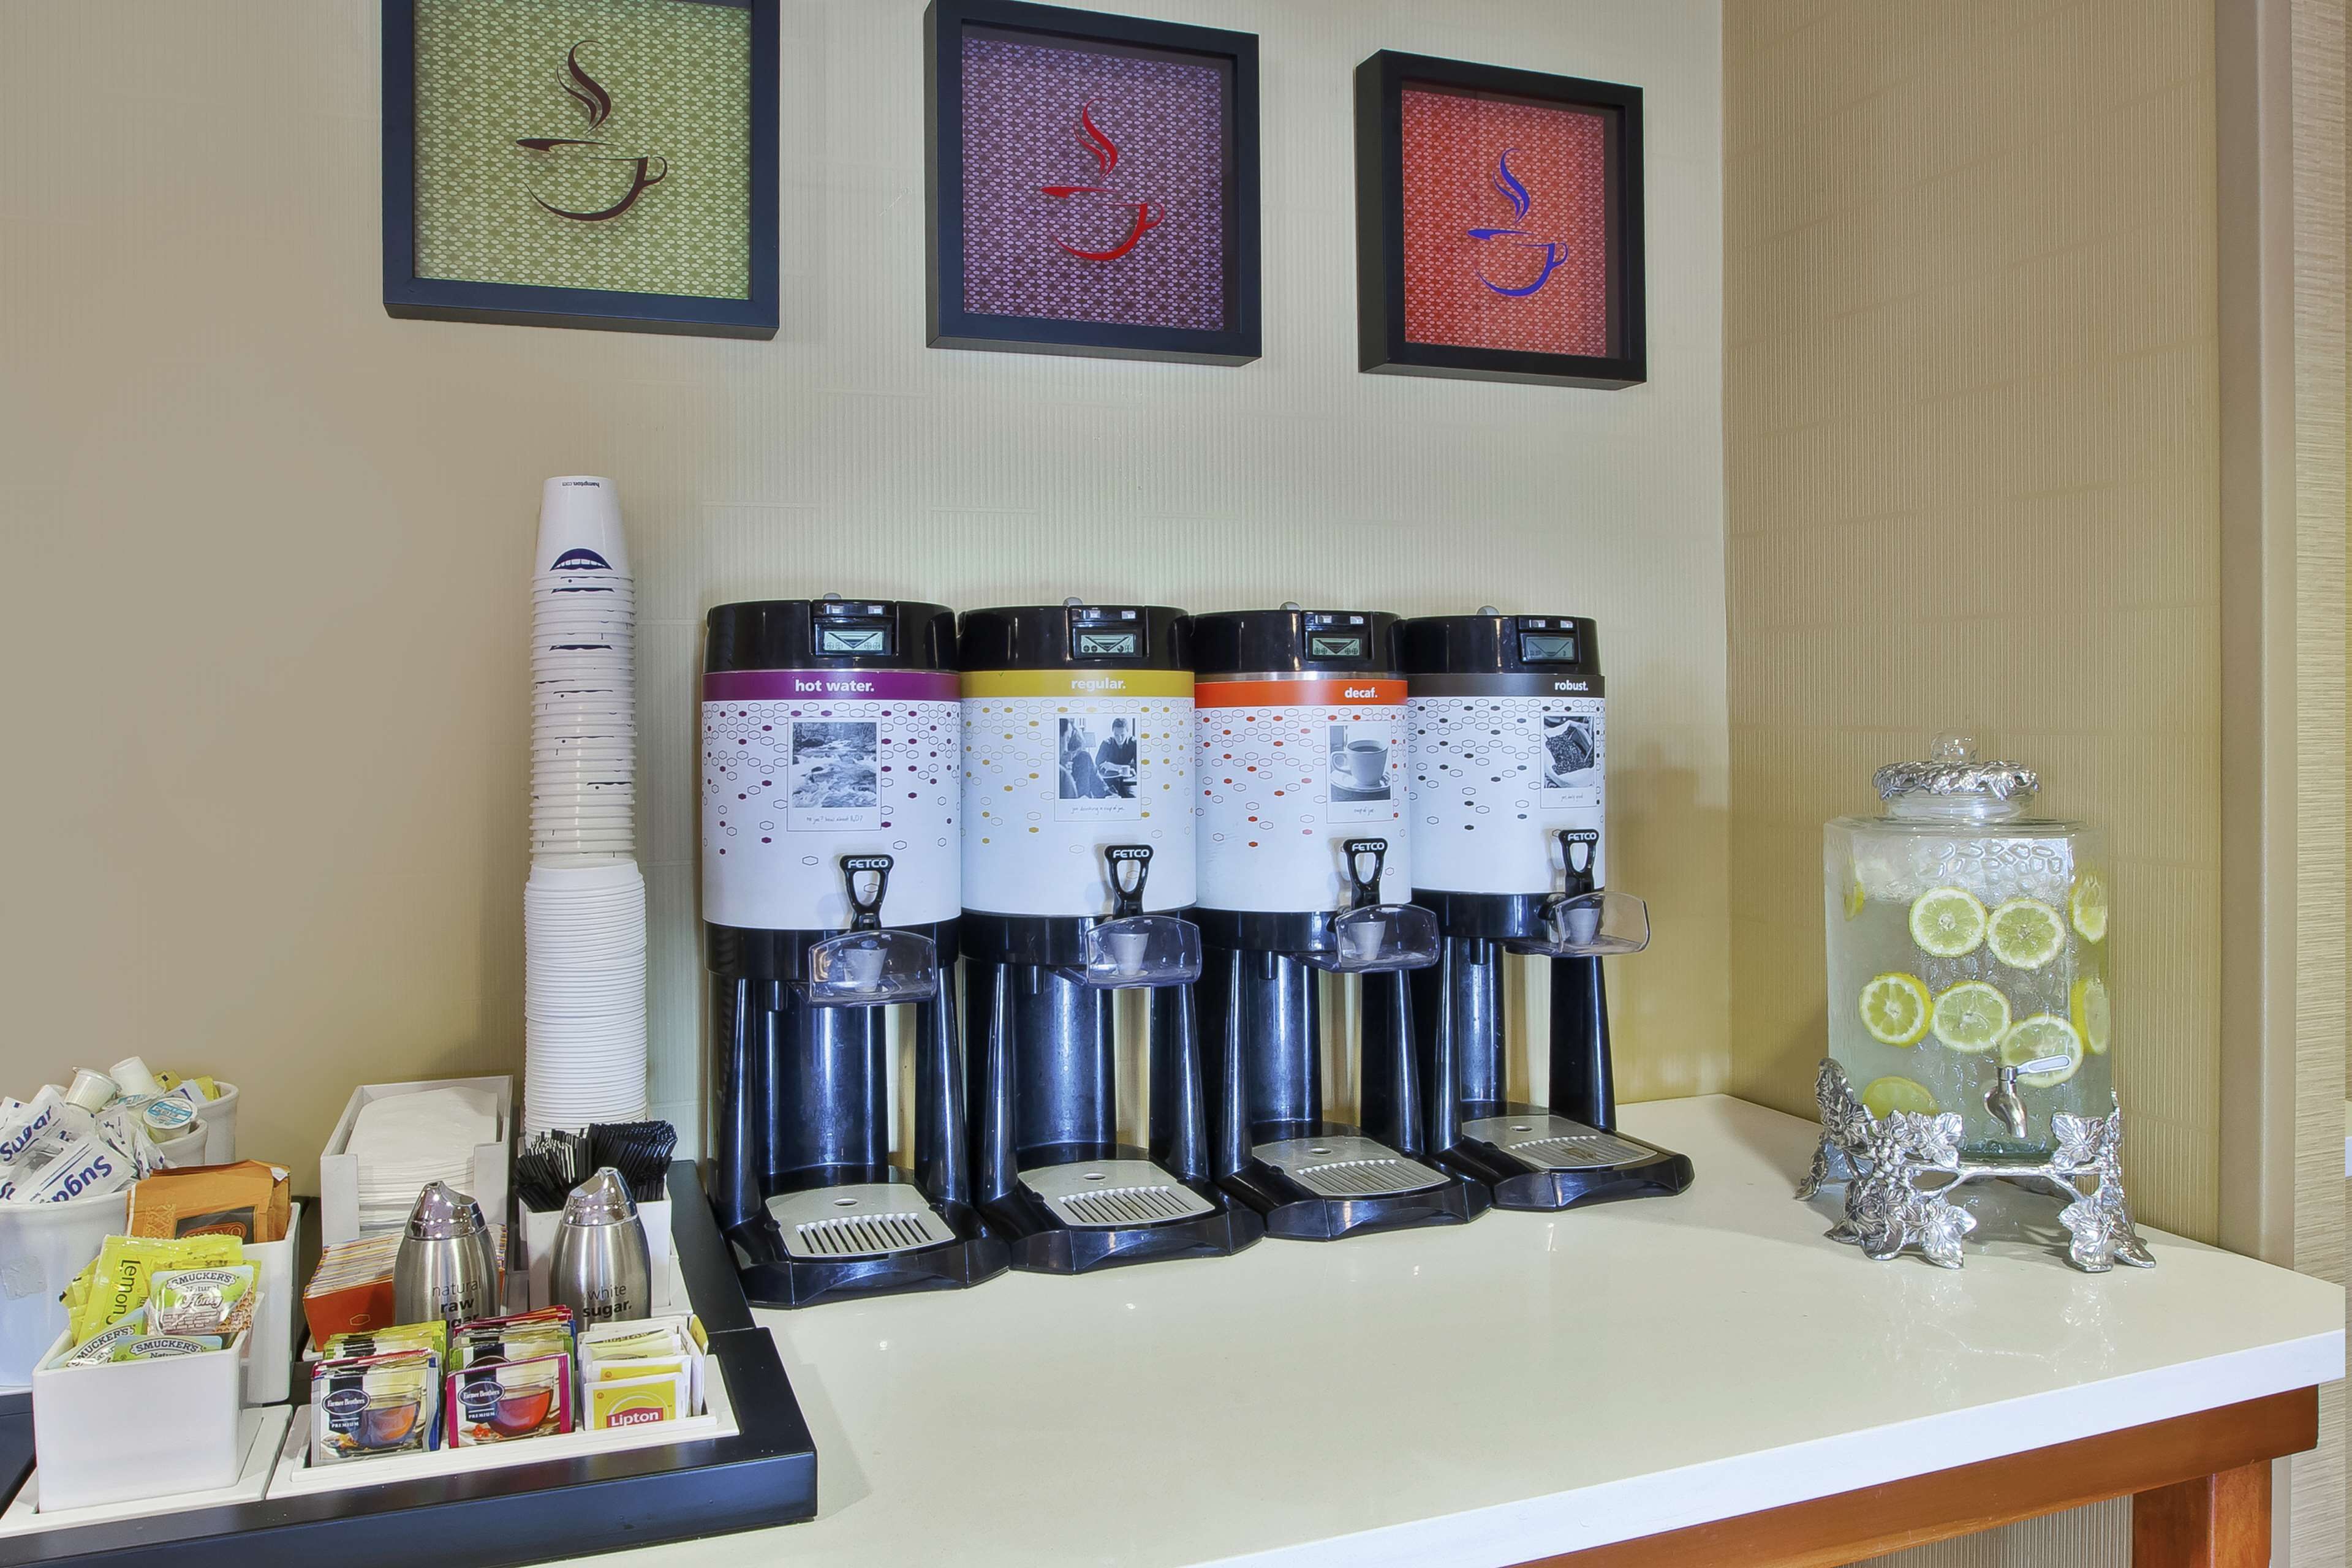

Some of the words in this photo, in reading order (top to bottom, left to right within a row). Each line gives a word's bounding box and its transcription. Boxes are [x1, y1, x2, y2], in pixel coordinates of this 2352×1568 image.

[795, 679, 822, 692] hot
[826, 680, 874, 692] water.
[1071, 677, 1126, 692] regular.
[1554, 679, 1589, 691] robust.
[1345, 687, 1378, 698] decaf.
[1568, 832, 1597, 841] FETCO
[1113, 849, 1150, 858] FETCO
[1352, 842, 1385, 851] FETCO
[848, 859, 888, 869] FETCO
[51, 1155, 112, 1202] Suga
[113, 1259, 141, 1315] Lemon
[433, 1275, 481, 1297] natural
[587, 1285, 626, 1300] white
[441, 1298, 474, 1314] raw
[583, 1300, 632, 1318] sugar.
[137, 1340, 199, 1352] SMUCKER'S
[611, 1411, 659, 1426] Lipton
